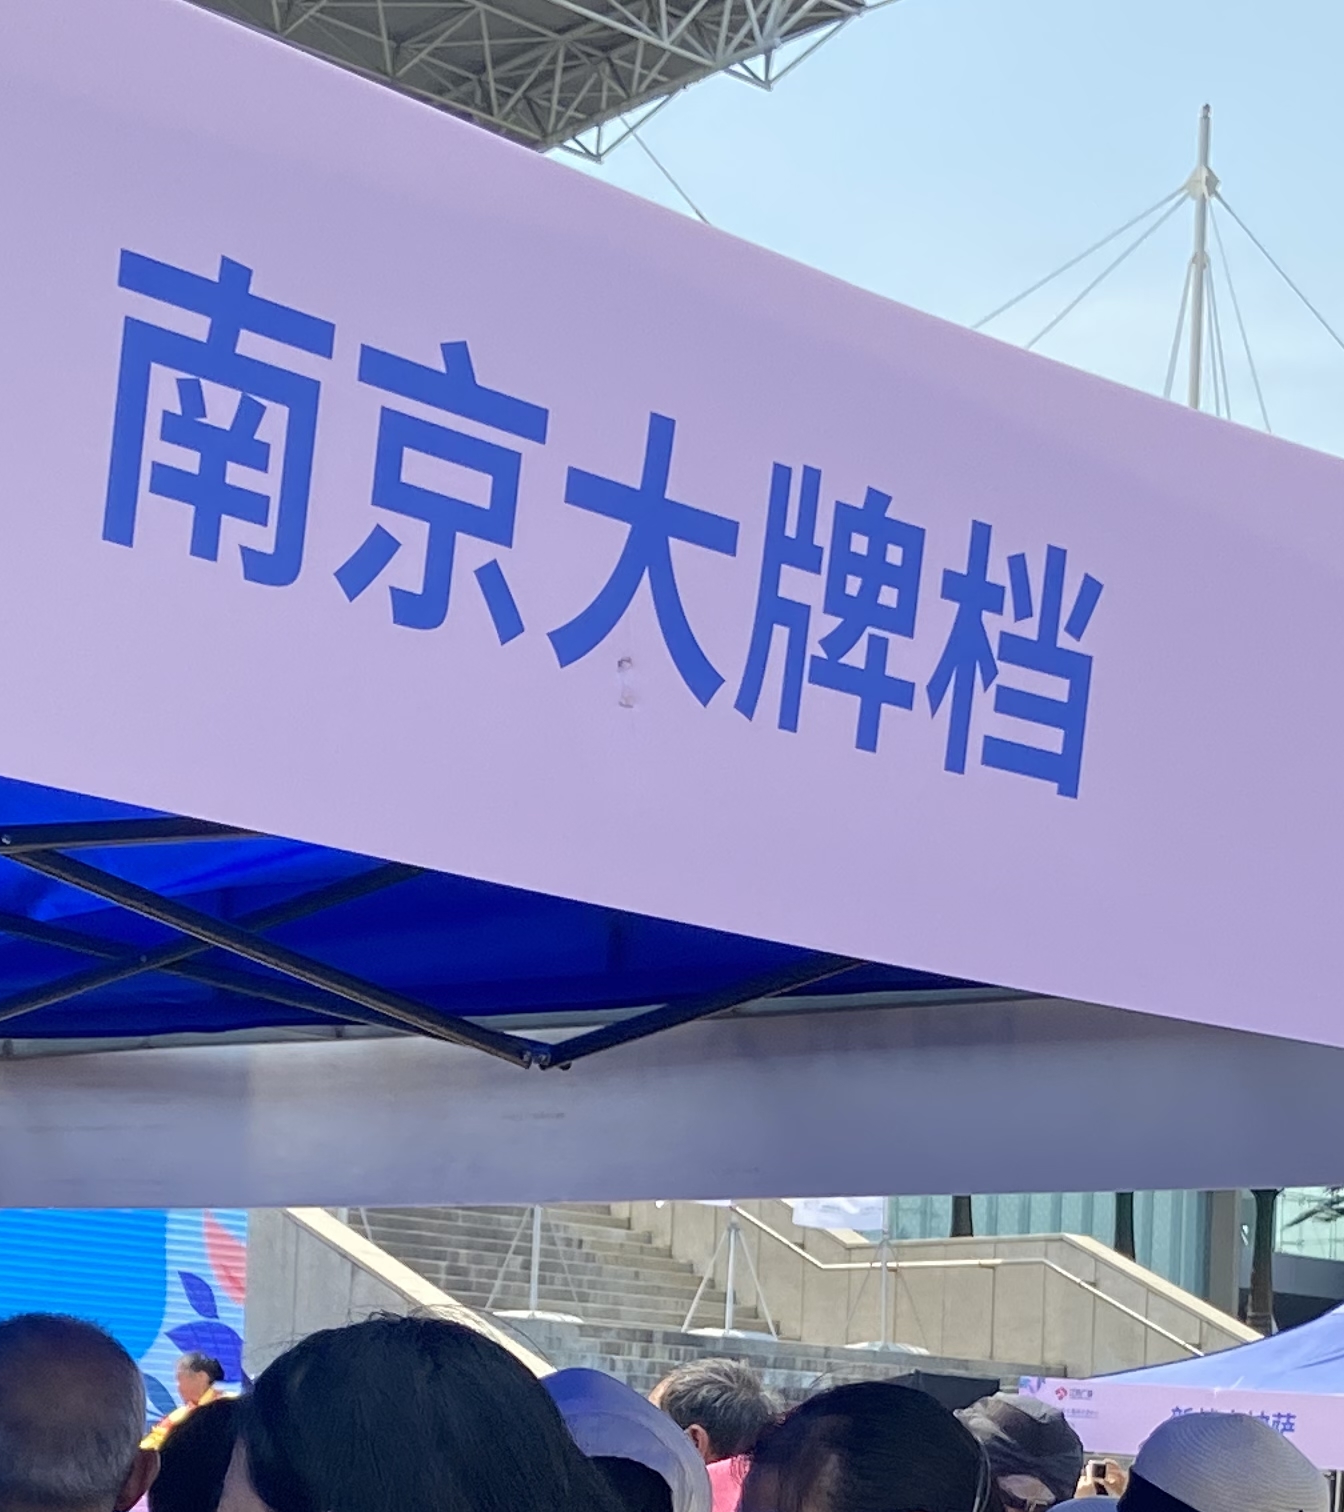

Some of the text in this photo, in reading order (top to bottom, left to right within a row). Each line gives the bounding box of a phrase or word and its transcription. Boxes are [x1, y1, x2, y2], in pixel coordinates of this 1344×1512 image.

[101, 247, 1105, 800] 南京大牌档
